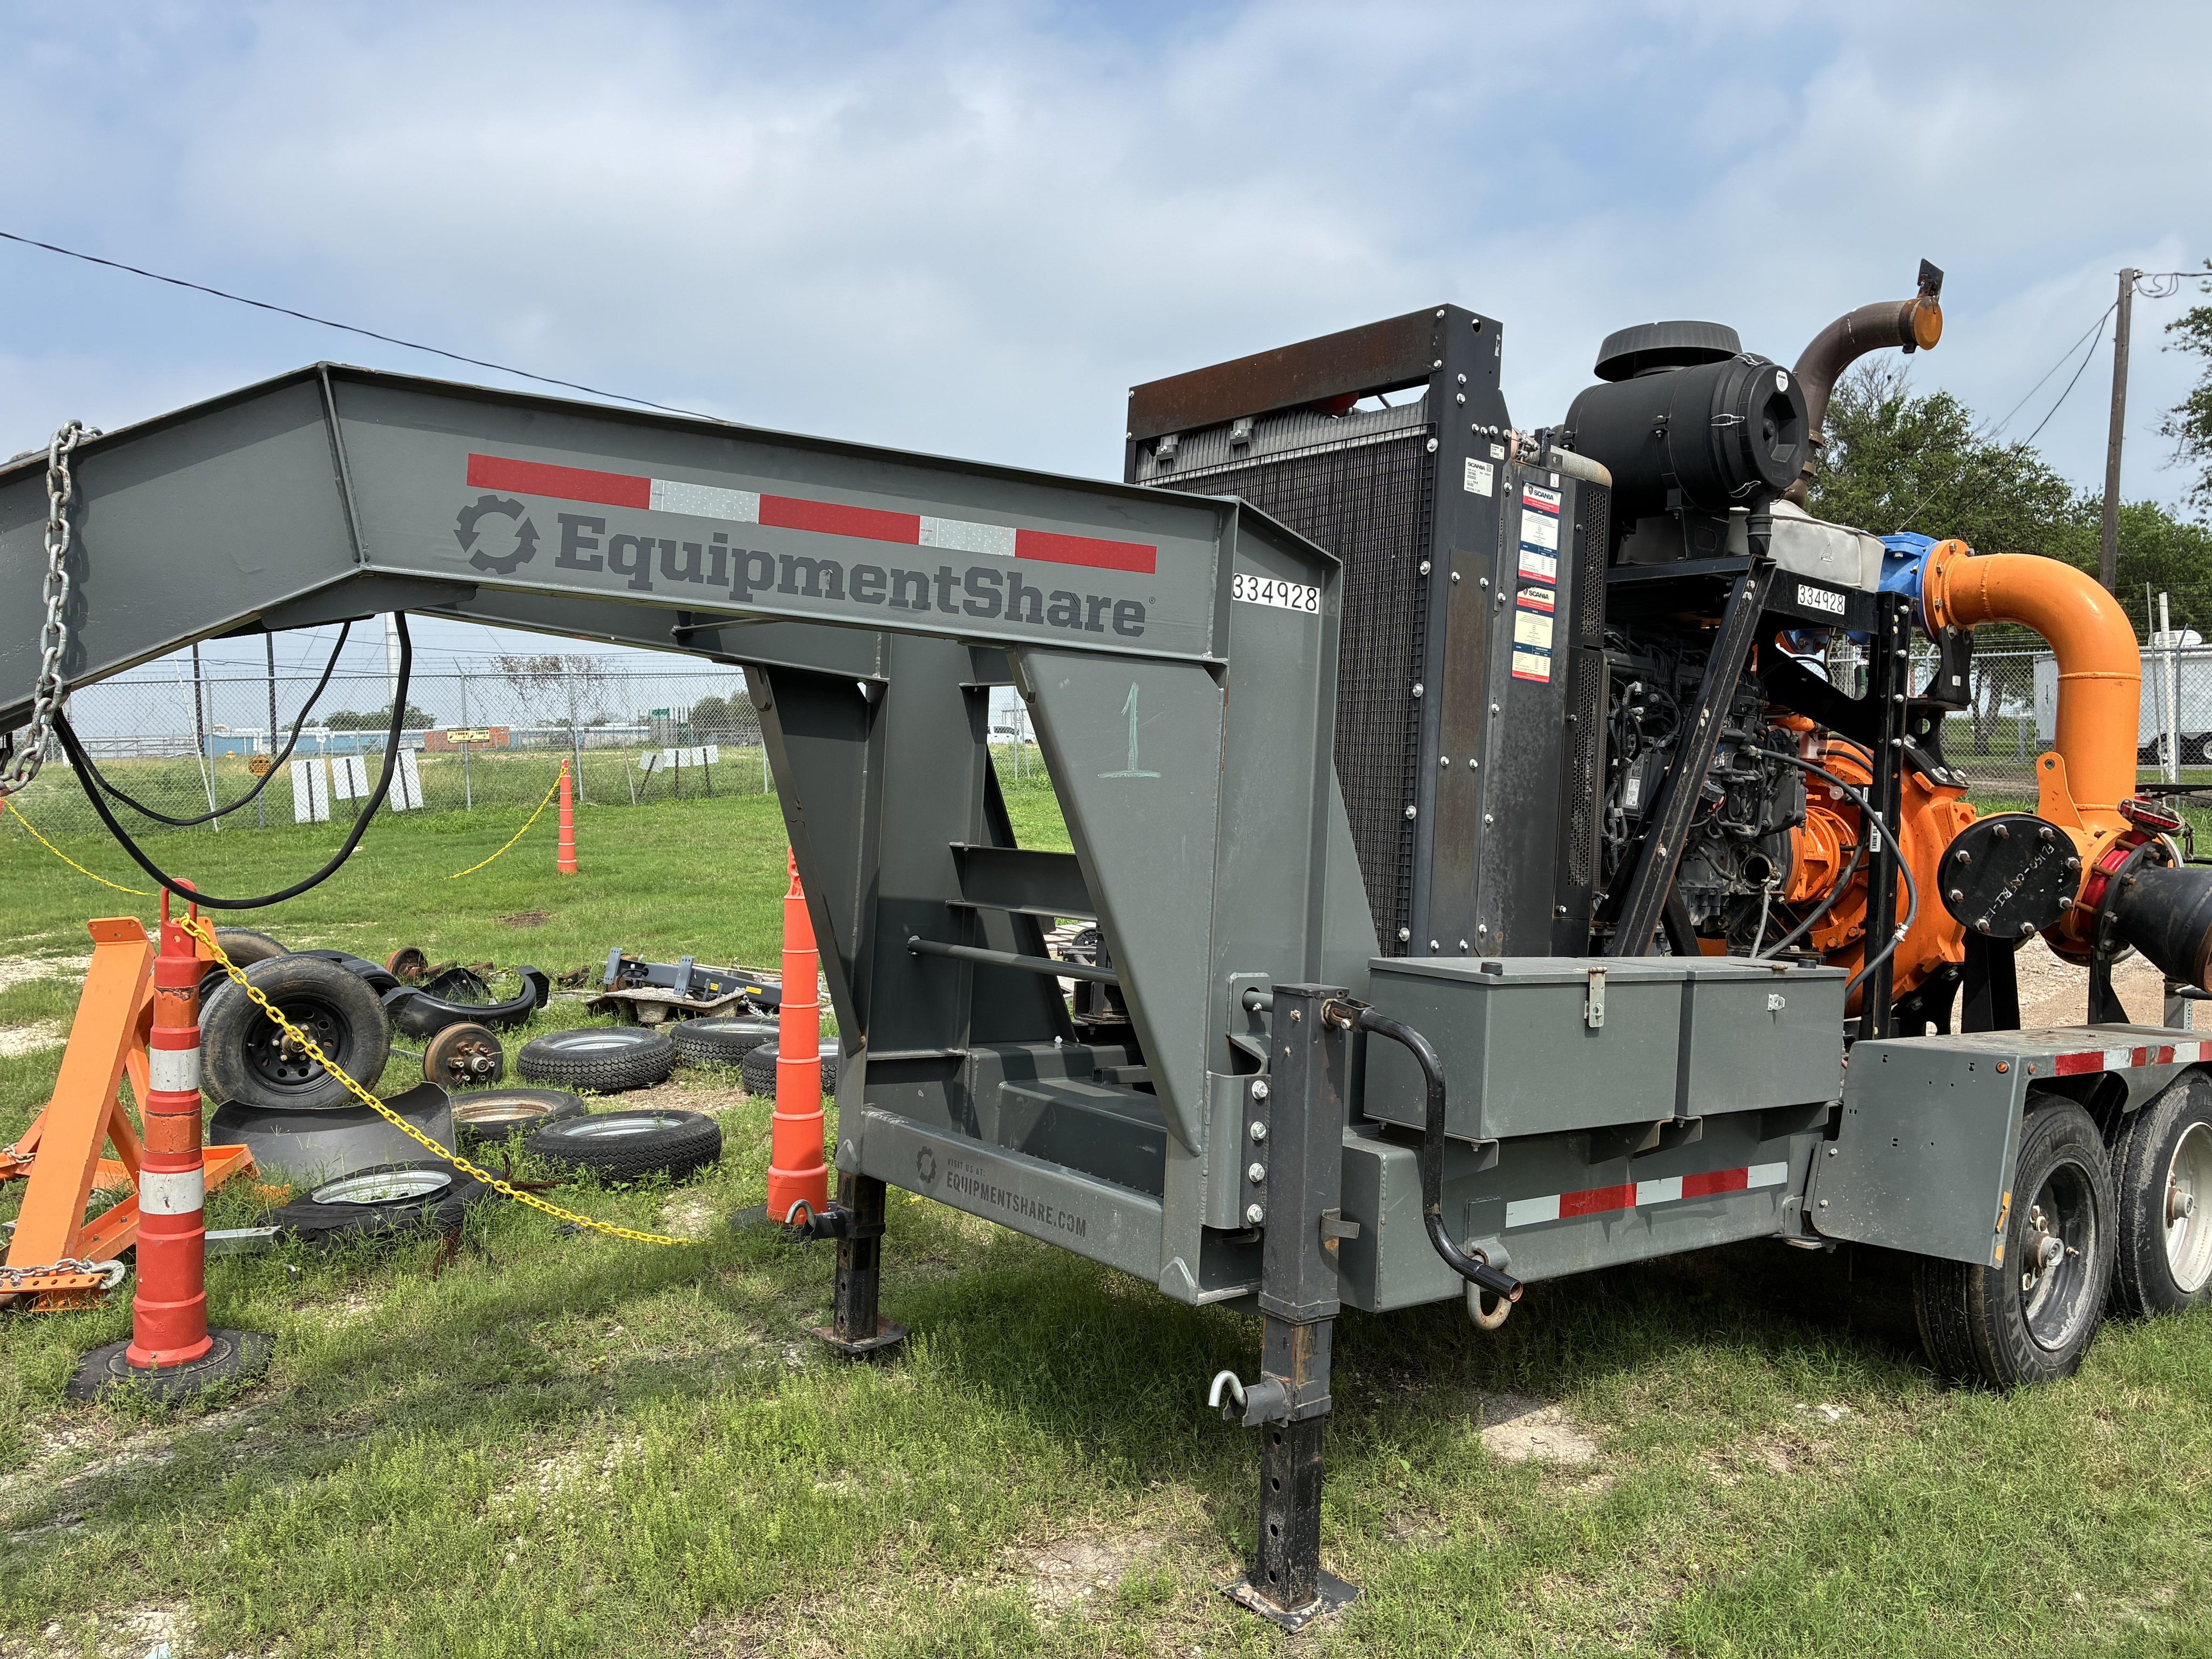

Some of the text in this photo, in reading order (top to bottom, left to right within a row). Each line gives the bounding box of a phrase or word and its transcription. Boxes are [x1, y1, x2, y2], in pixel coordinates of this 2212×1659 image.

[1467, 461, 1486, 471] SCANIA
[1534, 490, 1554, 501] SCANIA
[555, 512, 1146, 638] EquipmentShare
[1232, 574, 1317, 611] 334928
[1528, 590, 1549, 600] SCANIA
[1799, 585, 1843, 612] 334928
[1097, 682, 1162, 779] 1
[947, 1157, 986, 1177] VISIT US AT:
[947, 1170, 1087, 1238] EQUIPMENTSHARE.COM
